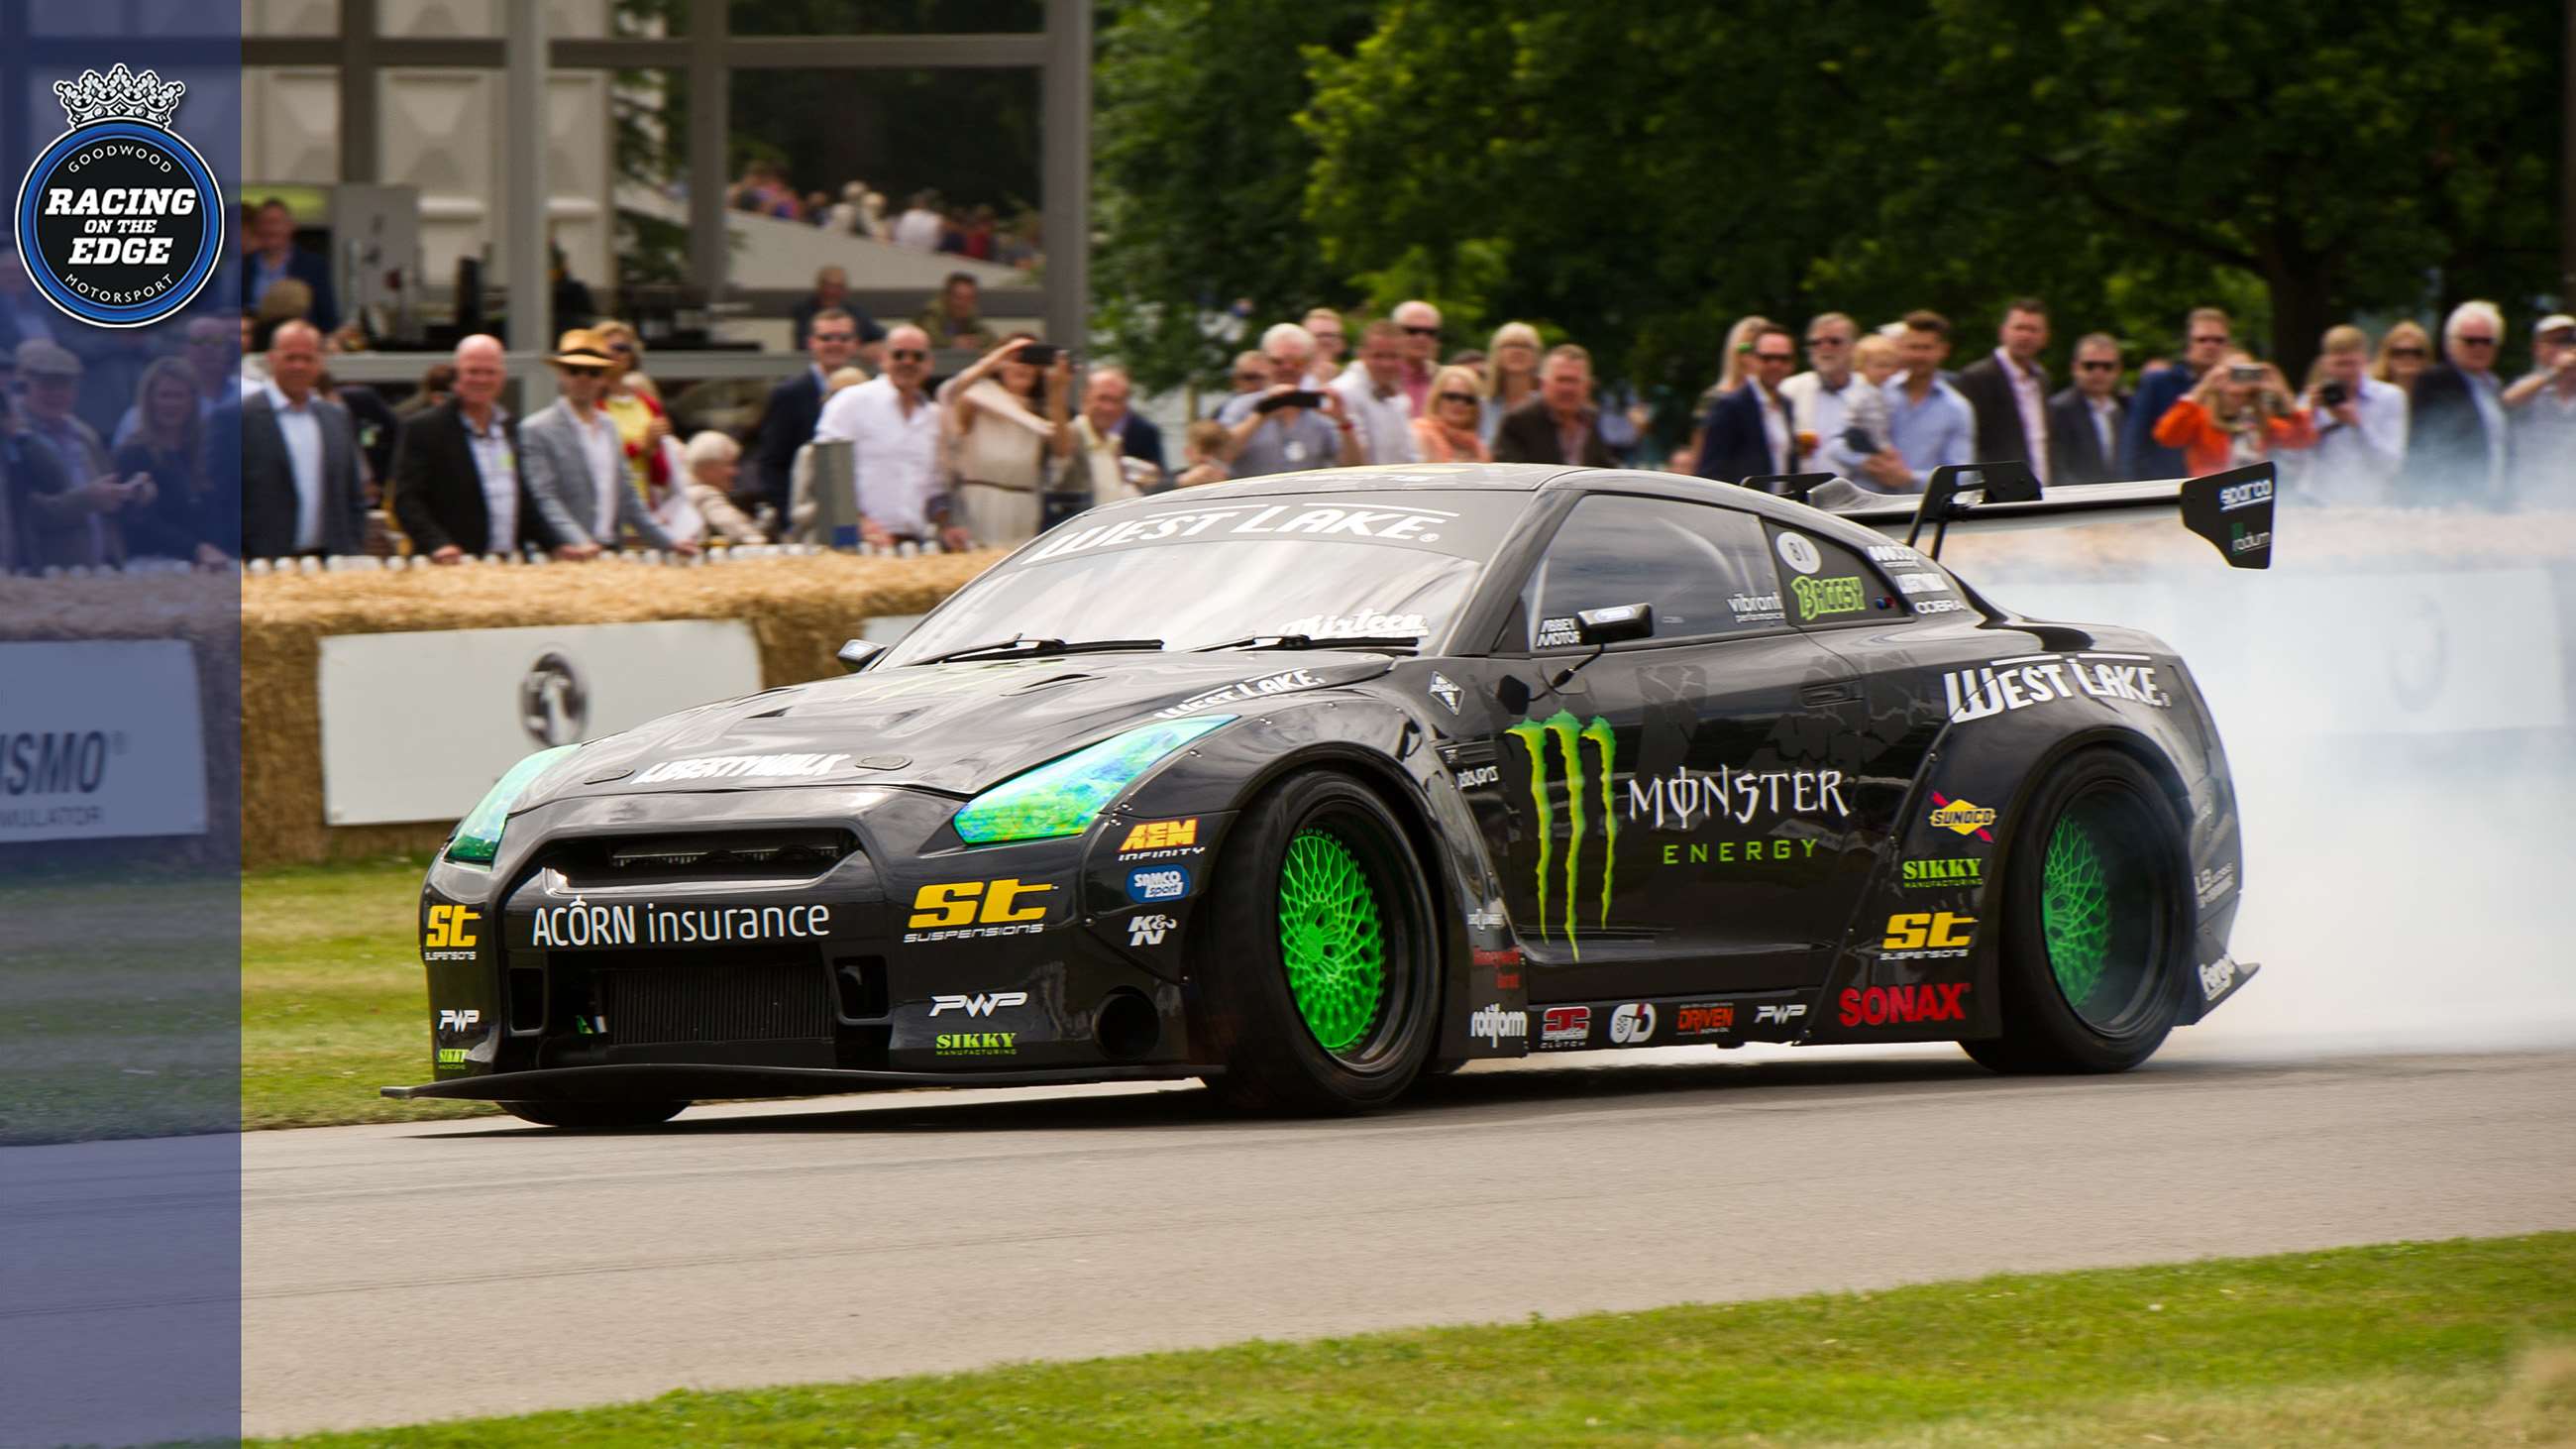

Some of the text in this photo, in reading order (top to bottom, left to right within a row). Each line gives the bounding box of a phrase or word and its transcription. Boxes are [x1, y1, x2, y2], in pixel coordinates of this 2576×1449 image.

[1021, 511, 1240, 564] WEST
[1153, 685, 1239, 720] WEST
[1944, 660, 2073, 724] WEST
[1628, 764, 1851, 830] MONSTER
[1933, 809, 1992, 826] SUNOCO
[1119, 819, 1198, 851] AEM
[1664, 838, 1817, 864] ENERGY
[1902, 857, 1983, 880] SIKKY
[532, 898, 831, 947] ACORN insurance
[903, 923, 1044, 943] SUSPENSIONS
[928, 991, 1027, 1018] PWP
[1754, 1003, 1808, 1025] PWP
[438, 1009, 481, 1033] PWP
[935, 1032, 1018, 1048] SIKKY
